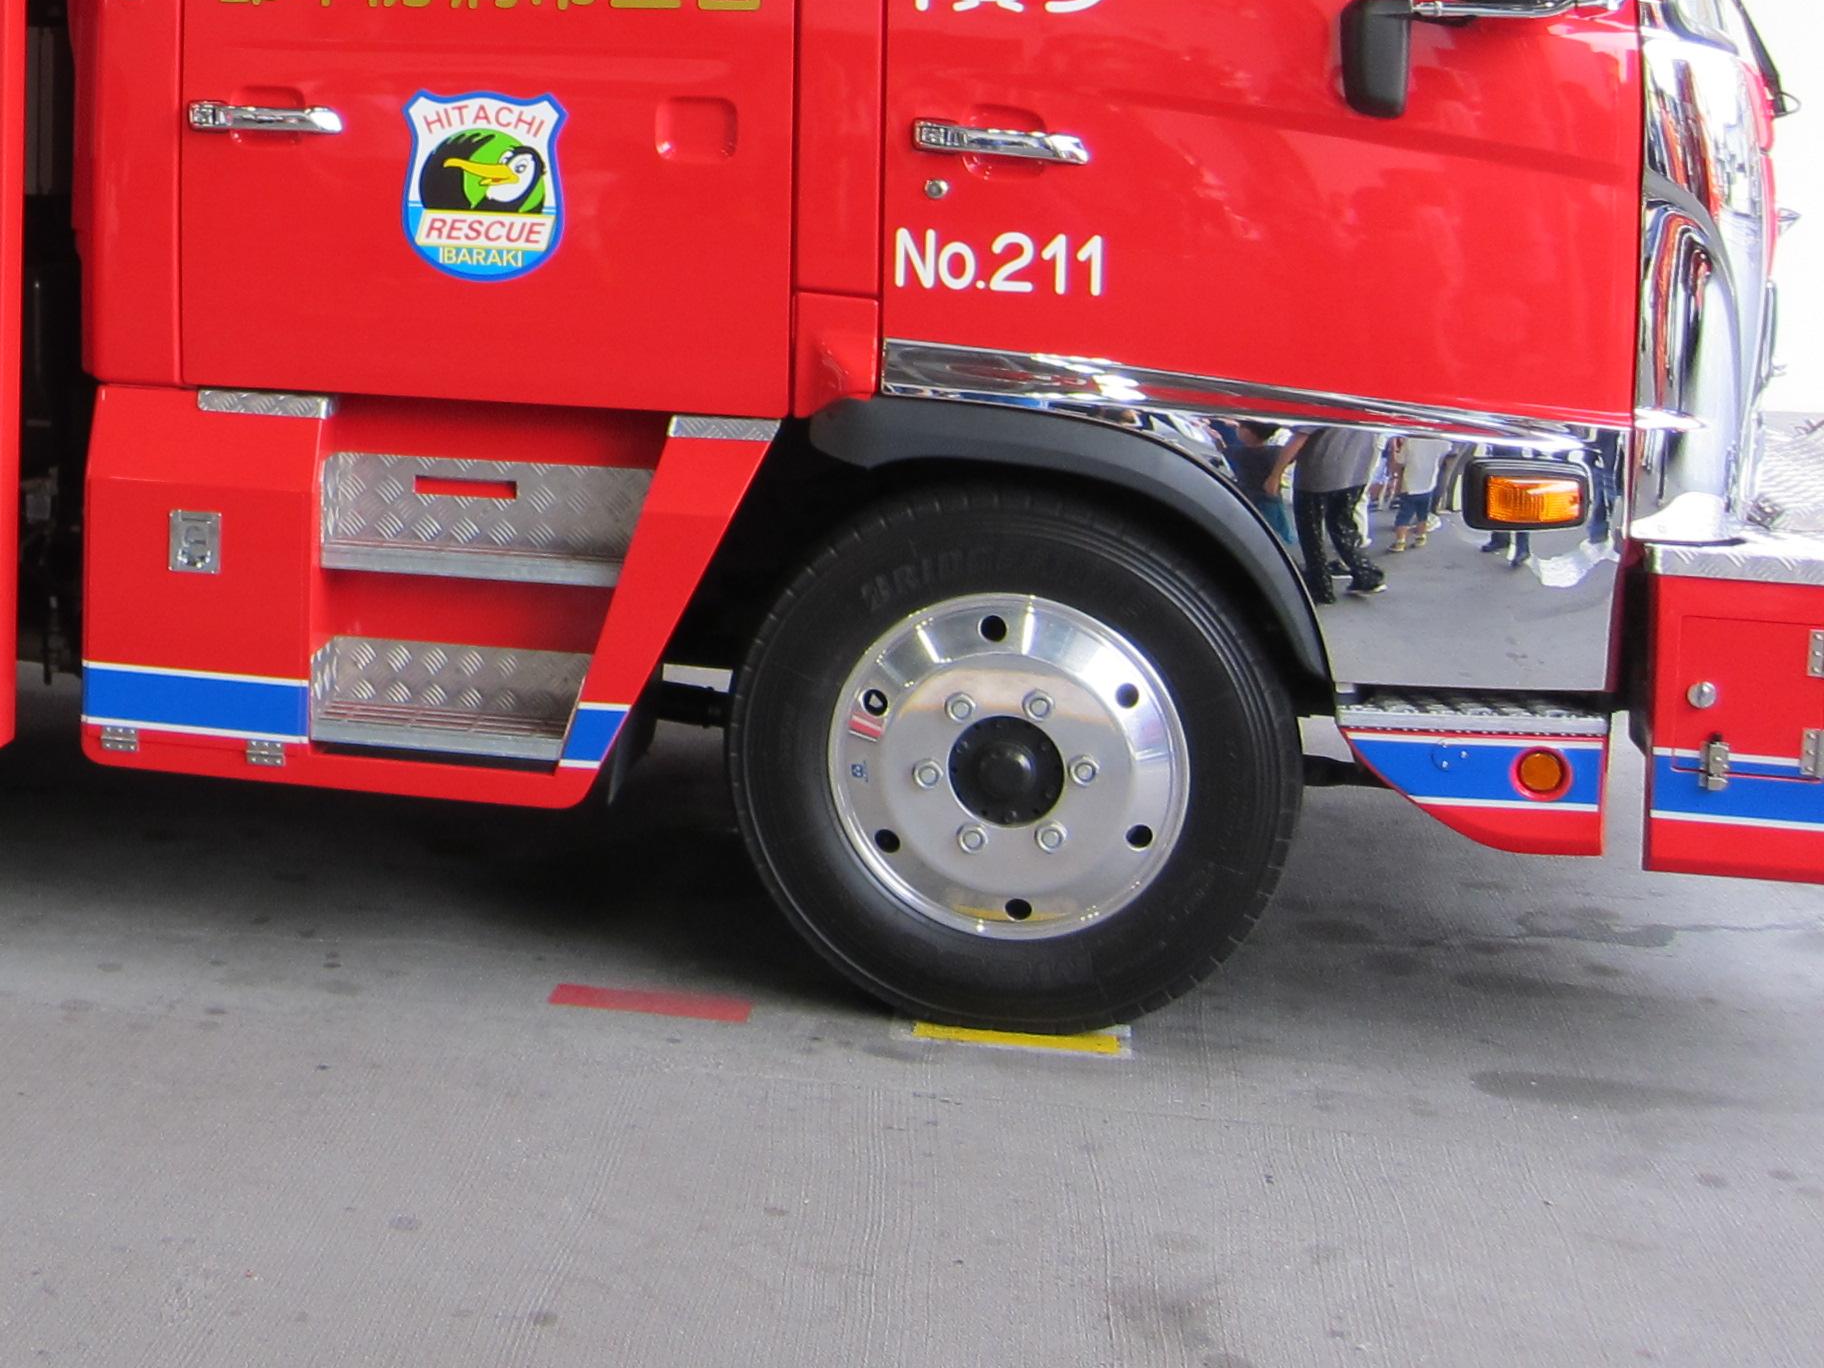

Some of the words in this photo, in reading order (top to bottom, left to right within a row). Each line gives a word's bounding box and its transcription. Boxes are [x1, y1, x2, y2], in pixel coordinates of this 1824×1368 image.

[422, 104, 546, 139] HITACHI
[425, 217, 546, 245] RESCUE
[438, 246, 524, 268] IBARAKI
[894, 229, 1107, 297] No.211
